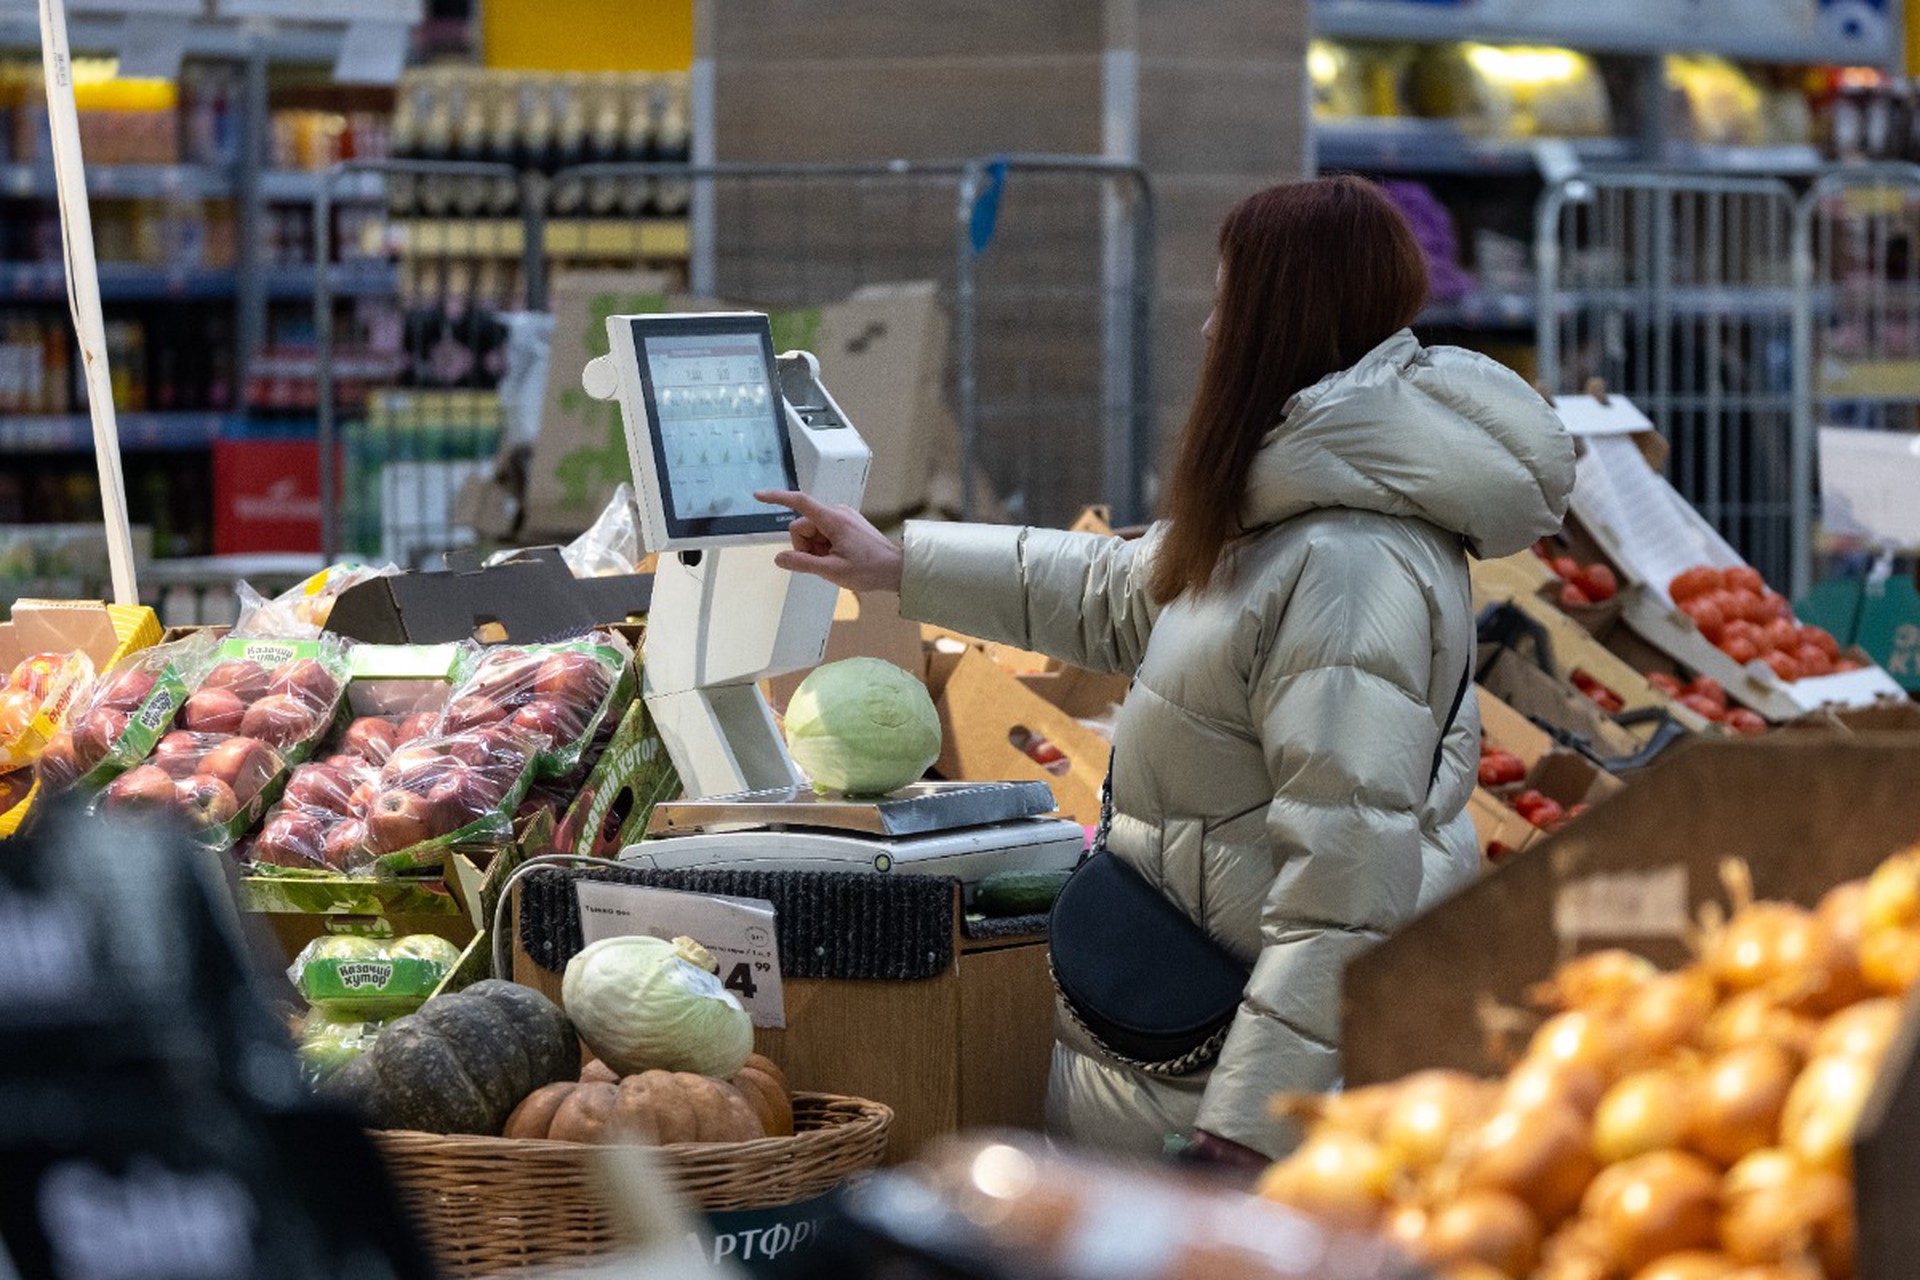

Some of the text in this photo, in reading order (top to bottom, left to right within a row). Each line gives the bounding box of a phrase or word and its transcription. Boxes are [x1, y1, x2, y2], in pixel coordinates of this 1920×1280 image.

[618, 736, 658, 780] ХУТОР
[339, 965, 391, 978] Казачий
[755, 962, 771, 973] 99
[344, 974, 387, 988] хутор
